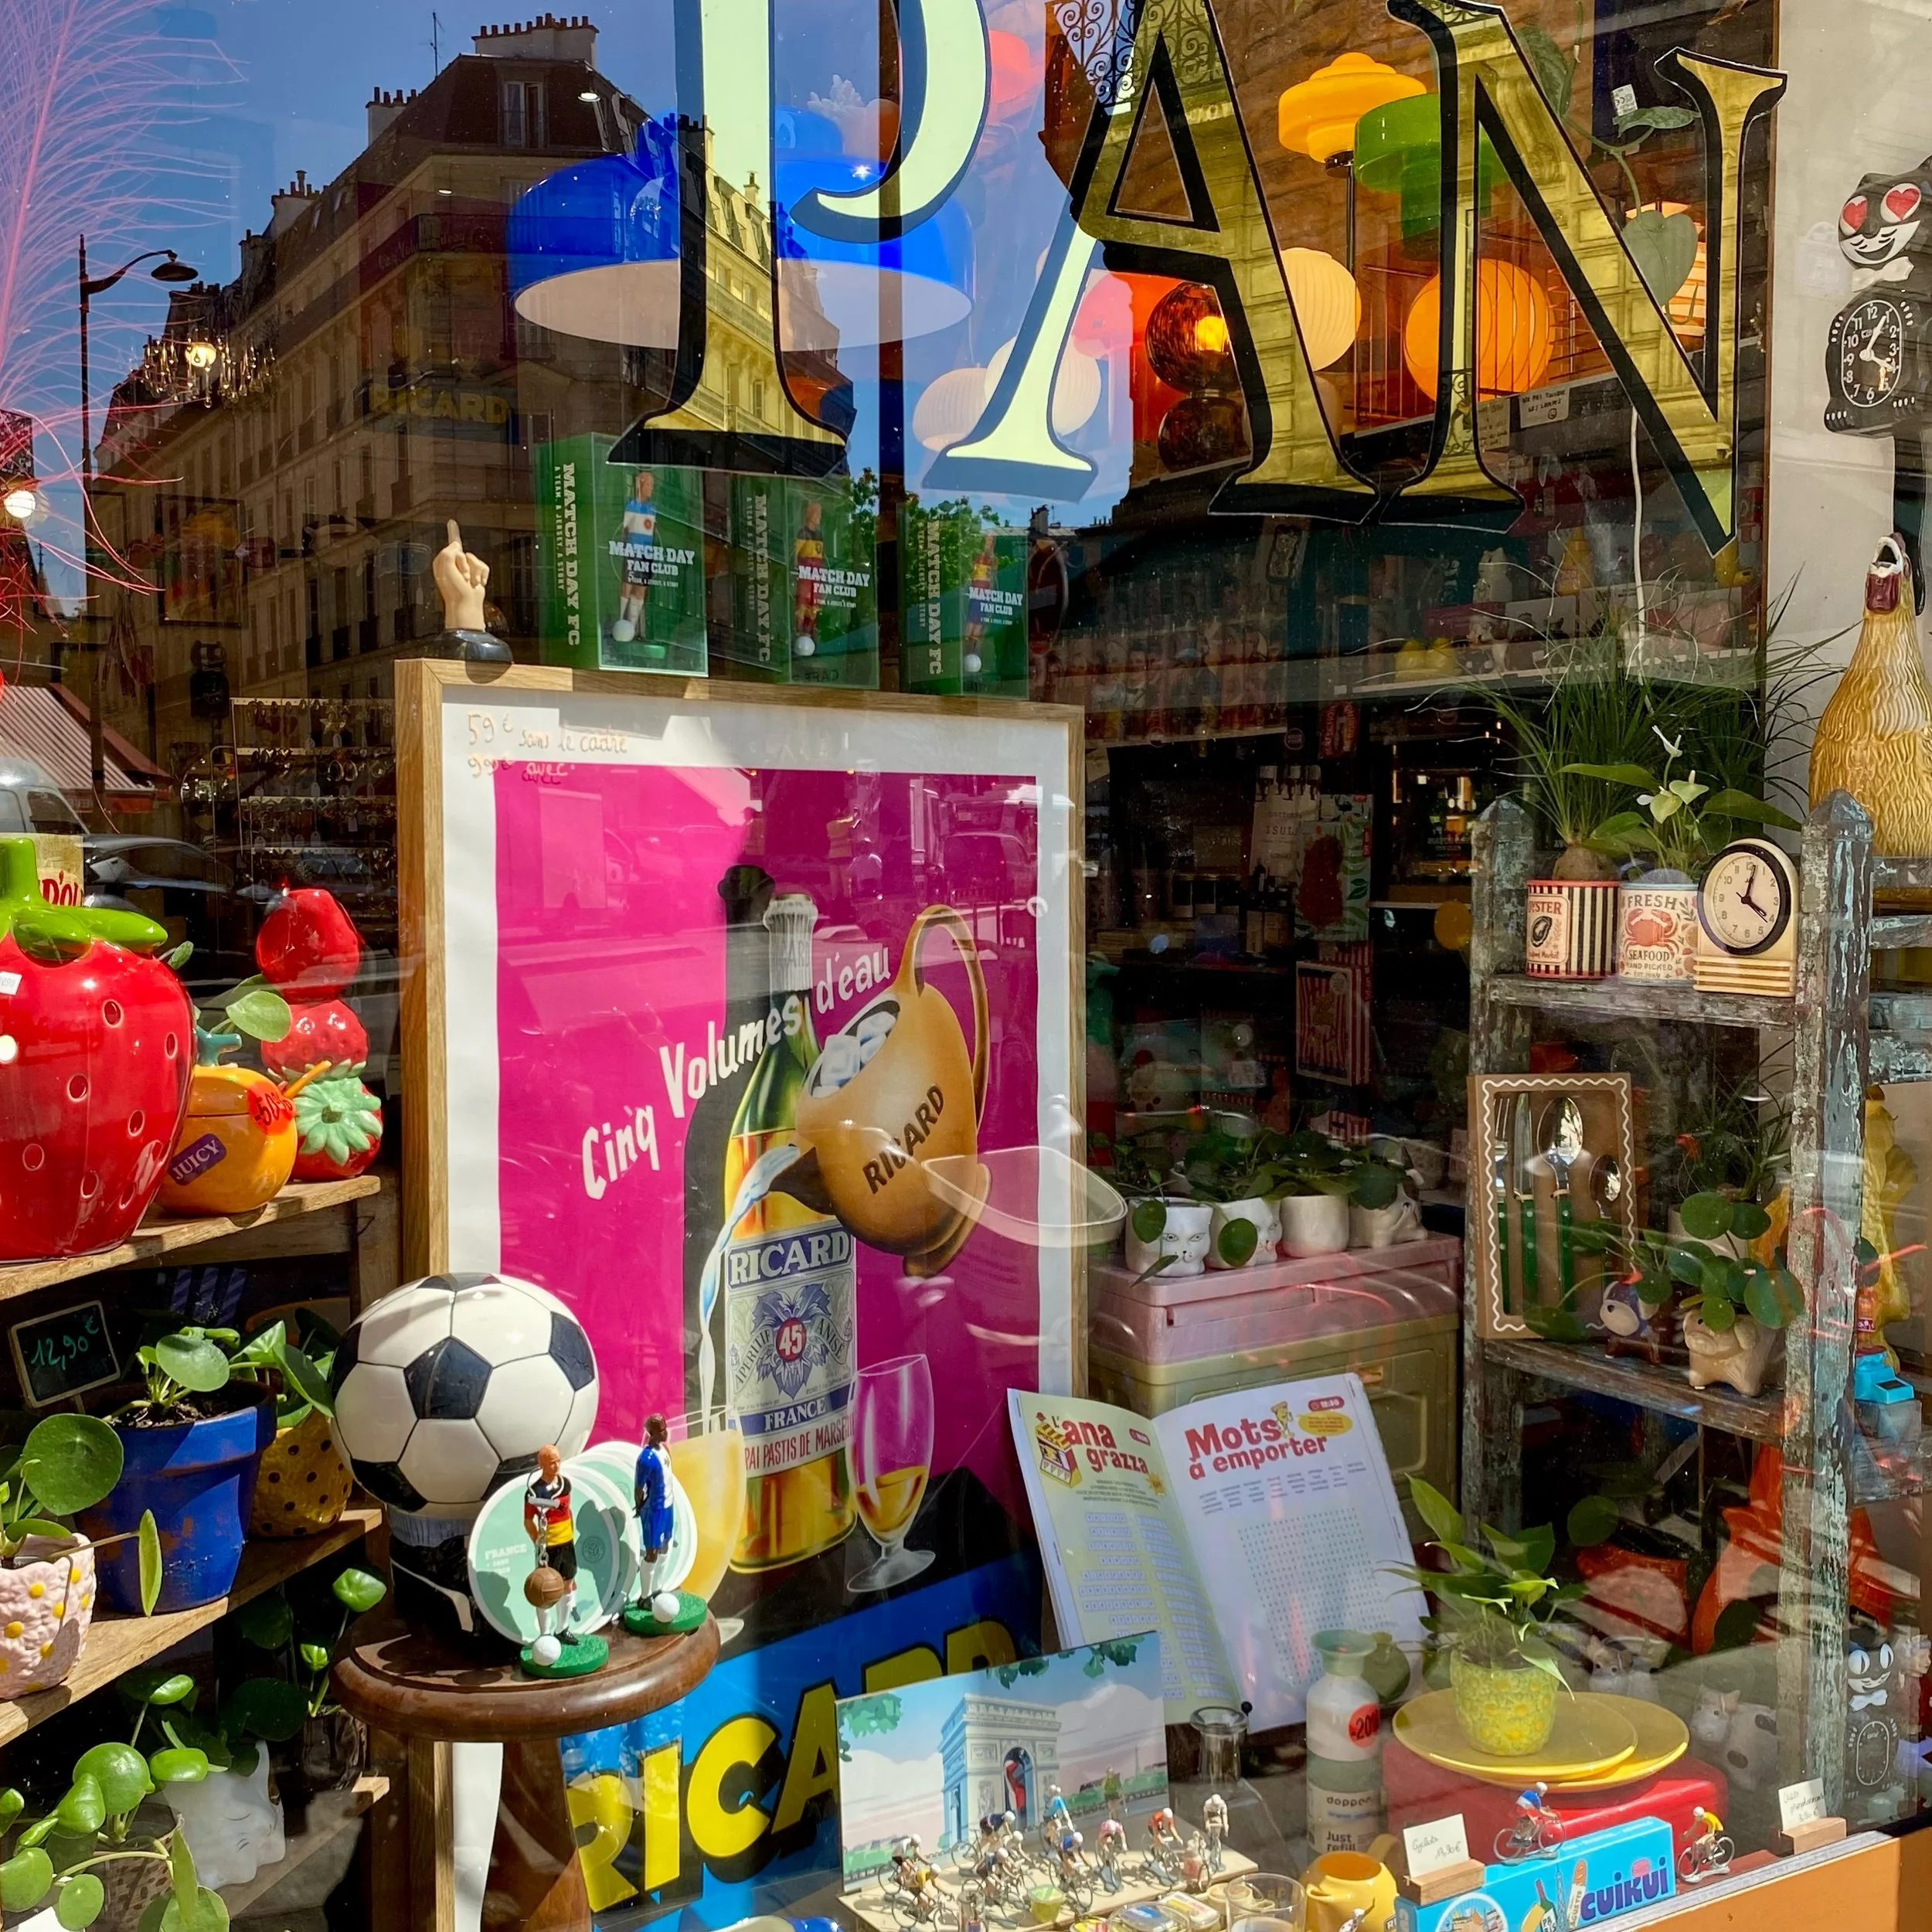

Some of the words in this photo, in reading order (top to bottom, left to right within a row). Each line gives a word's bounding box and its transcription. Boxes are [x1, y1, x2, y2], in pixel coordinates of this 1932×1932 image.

[607, 0, 1787, 557] PAN
[1867, 306, 1878, 320] 12
[1852, 317, 1862, 331] 11
[1889, 325, 1897, 338] 2
[1847, 334, 1859, 348] 10
[1889, 343, 1897, 356] 3
[1845, 353, 1855, 366] 9
[1845, 370, 1853, 383] 8
[1852, 383, 1861, 396] 7
[1866, 387, 1875, 400] 6
[563, 462, 577, 556] MATCH
[754, 494, 769, 580] MATCH
[608, 540, 665, 563] MATCH
[666, 548, 696, 565] DAY
[927, 519, 940, 599] MATCH
[627, 559, 650, 573] FAN
[651, 563, 679, 576] CLUB
[798, 565, 845, 584] MATCH
[846, 573, 870, 587] DAY
[565, 560, 579, 610] DAY
[813, 582, 832, 595] FAN
[833, 585, 857, 597] CLUB
[968, 586, 1004, 604] MATCH
[1005, 592, 1023, 607] DAY
[757, 583, 770, 629] DAY
[979, 602, 995, 614] FAN
[995, 604, 1013, 616] CLUB
[566, 614, 580, 646] FC
[927, 602, 941, 645] DAY
[757, 632, 770, 662] FC
[929, 648, 941, 675] FC
[1734, 865, 1740, 874] 11
[1723, 876, 1733, 885] 10
[1770, 878, 1776, 887] 2
[1627, 893, 1678, 910] FRESH
[1718, 893, 1725, 903] 9
[1774, 896, 1779, 906] 3
[1721, 910, 1727, 920] 8
[1769, 914, 1775, 923] 4
[1732, 924, 1738, 933] 7
[1744, 929, 1750, 938] 6
[1757, 926, 1764, 935] 5
[1628, 949, 1670, 961] SEAFOOD
[581, 1104, 661, 1201] Cinq
[658, 995, 801, 1119] Volumes
[815, 947, 892, 1015] d'eau
[172, 1139, 221, 1180] JUICY
[729, 1230, 850, 1287] RICARD
[764, 1396, 827, 1432] FRANCE
[1184, 1417, 1282, 1460] Mots
[763, 1437, 797, 1469] PASTIS
[799, 1430, 811, 1458] DE
[1212, 1434, 1328, 1471] emporter
[1086, 1447, 1150, 1475] grazza
[1326, 1830, 1352, 1843] Just
